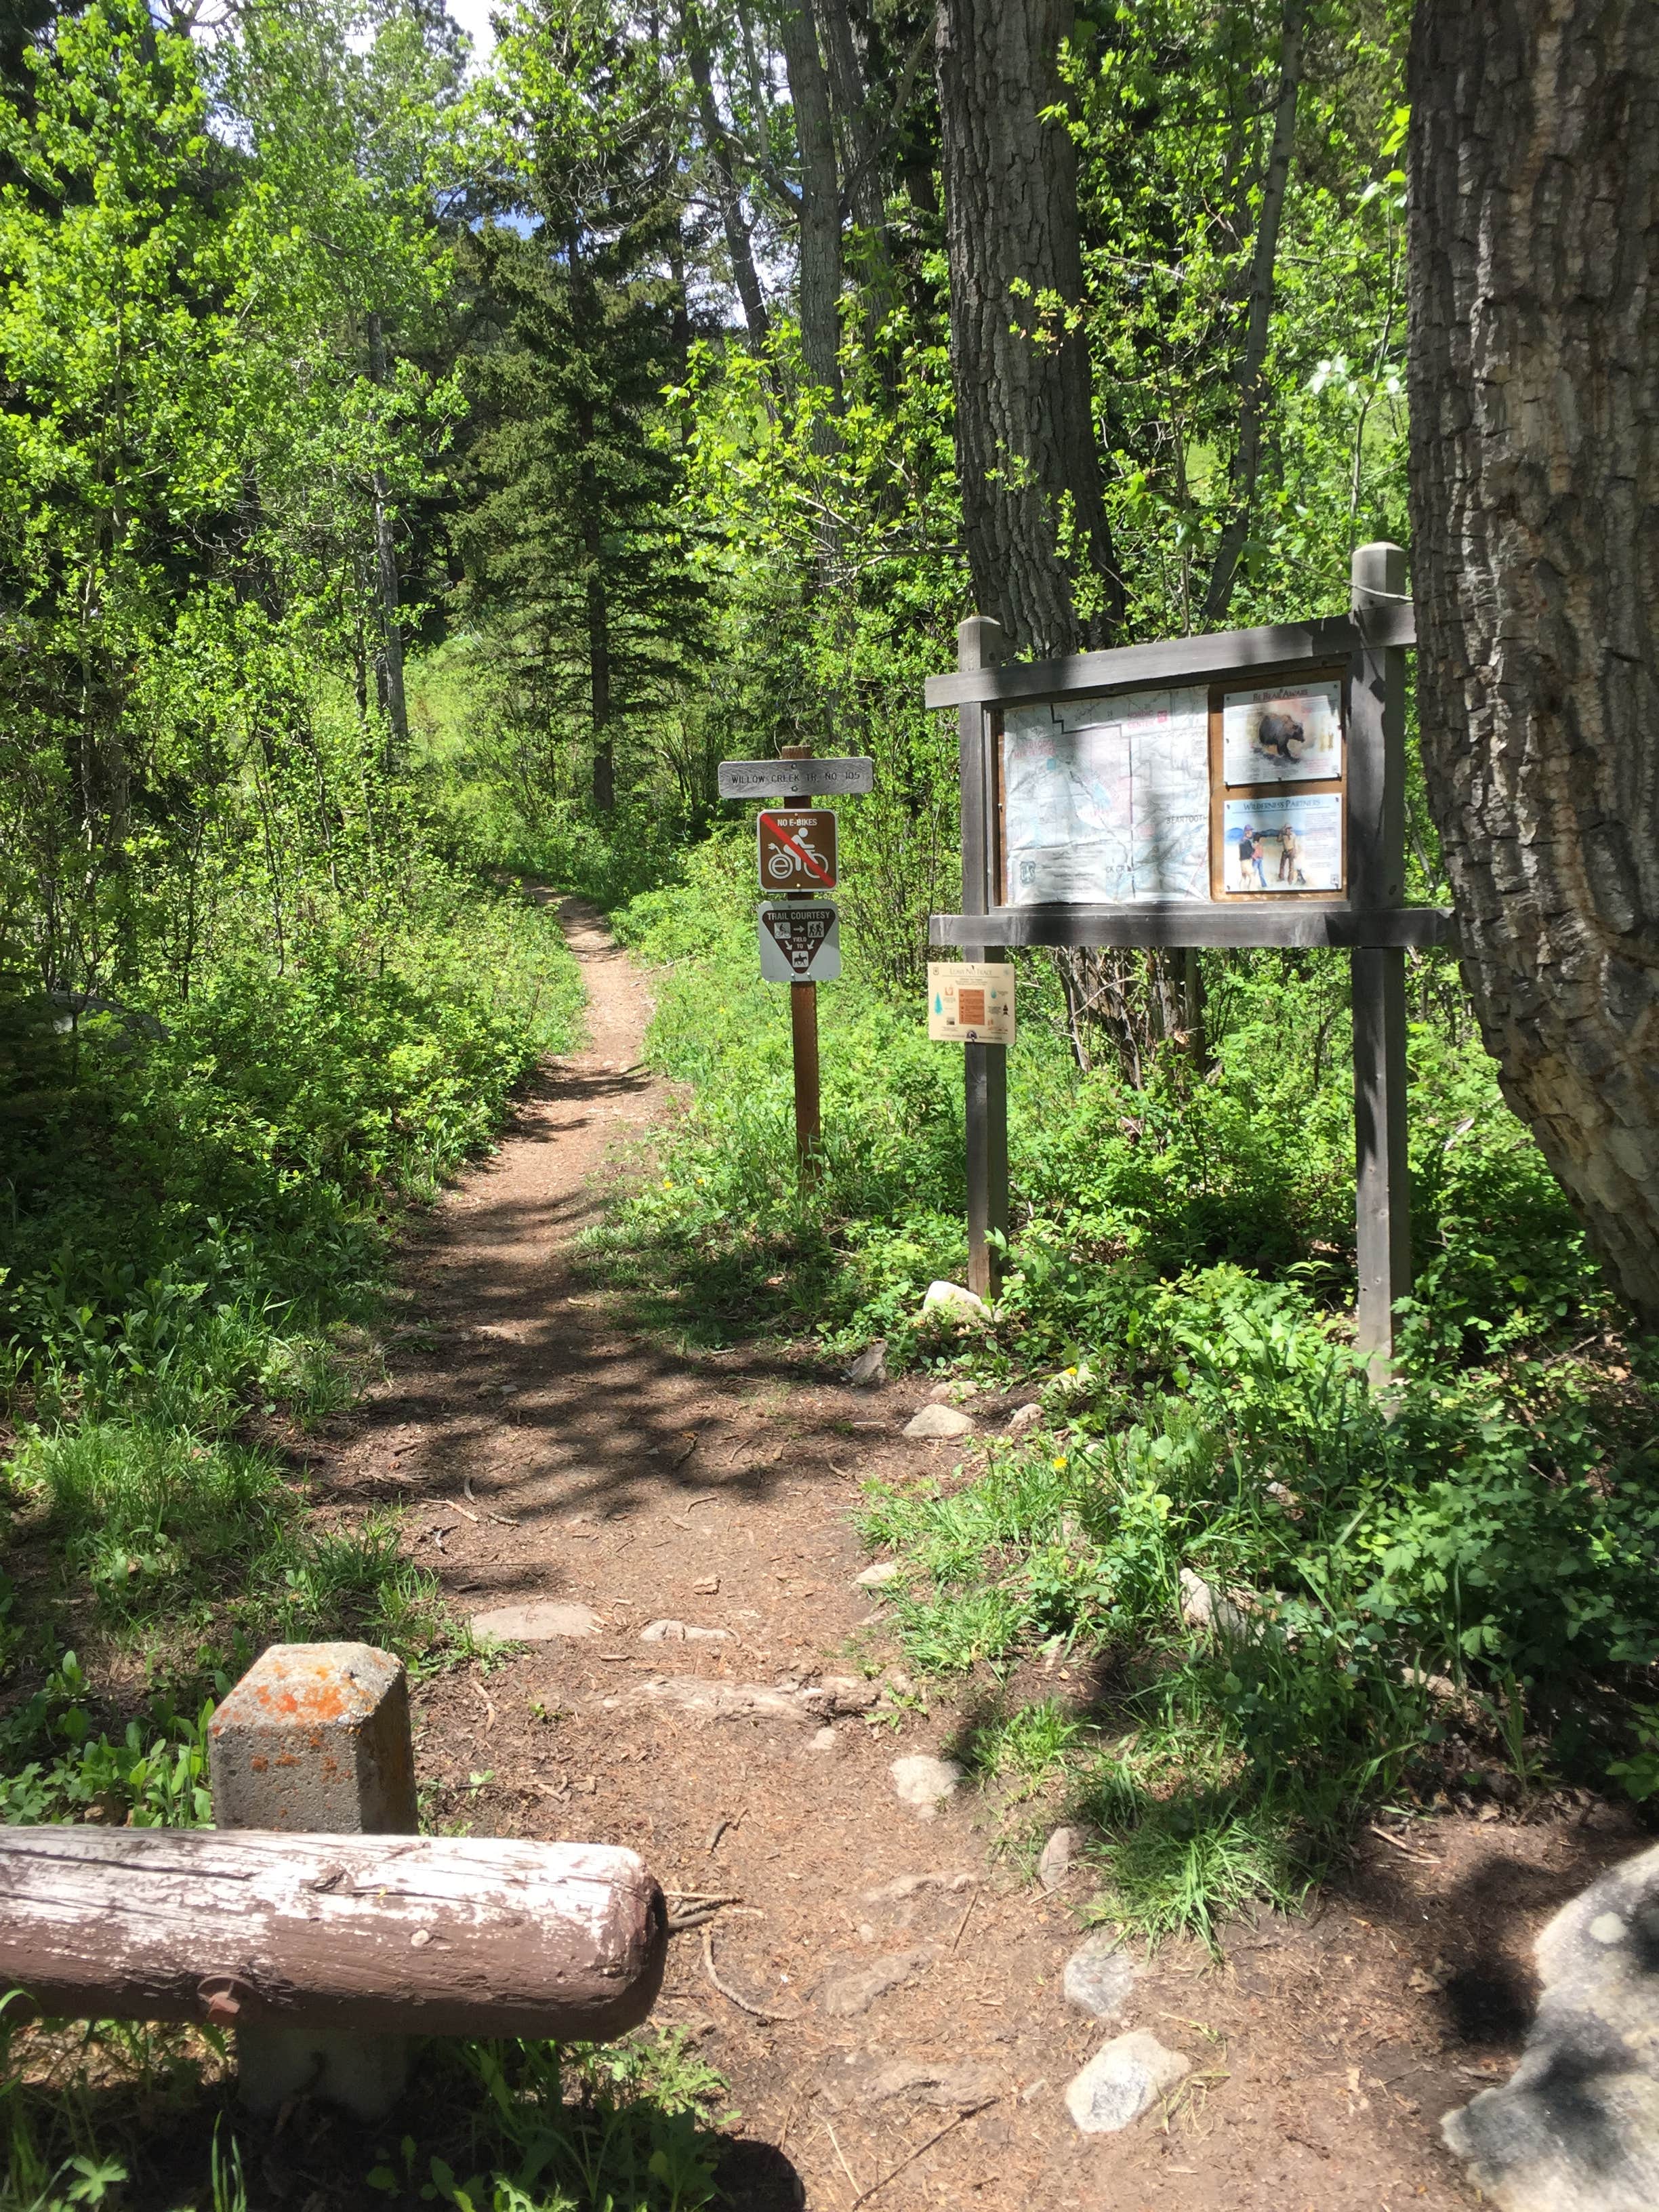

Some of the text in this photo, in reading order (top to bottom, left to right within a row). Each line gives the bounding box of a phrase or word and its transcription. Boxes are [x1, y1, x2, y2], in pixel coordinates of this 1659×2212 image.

[731, 775, 765, 783] WILLOW
[771, 775, 800, 783] CREEK
[1243, 800, 1320, 811] WILDERNESS PARTNERS
[777, 818, 817, 827] NO E-BIKES
[767, 911, 830, 920] TRAIL COURTESY
